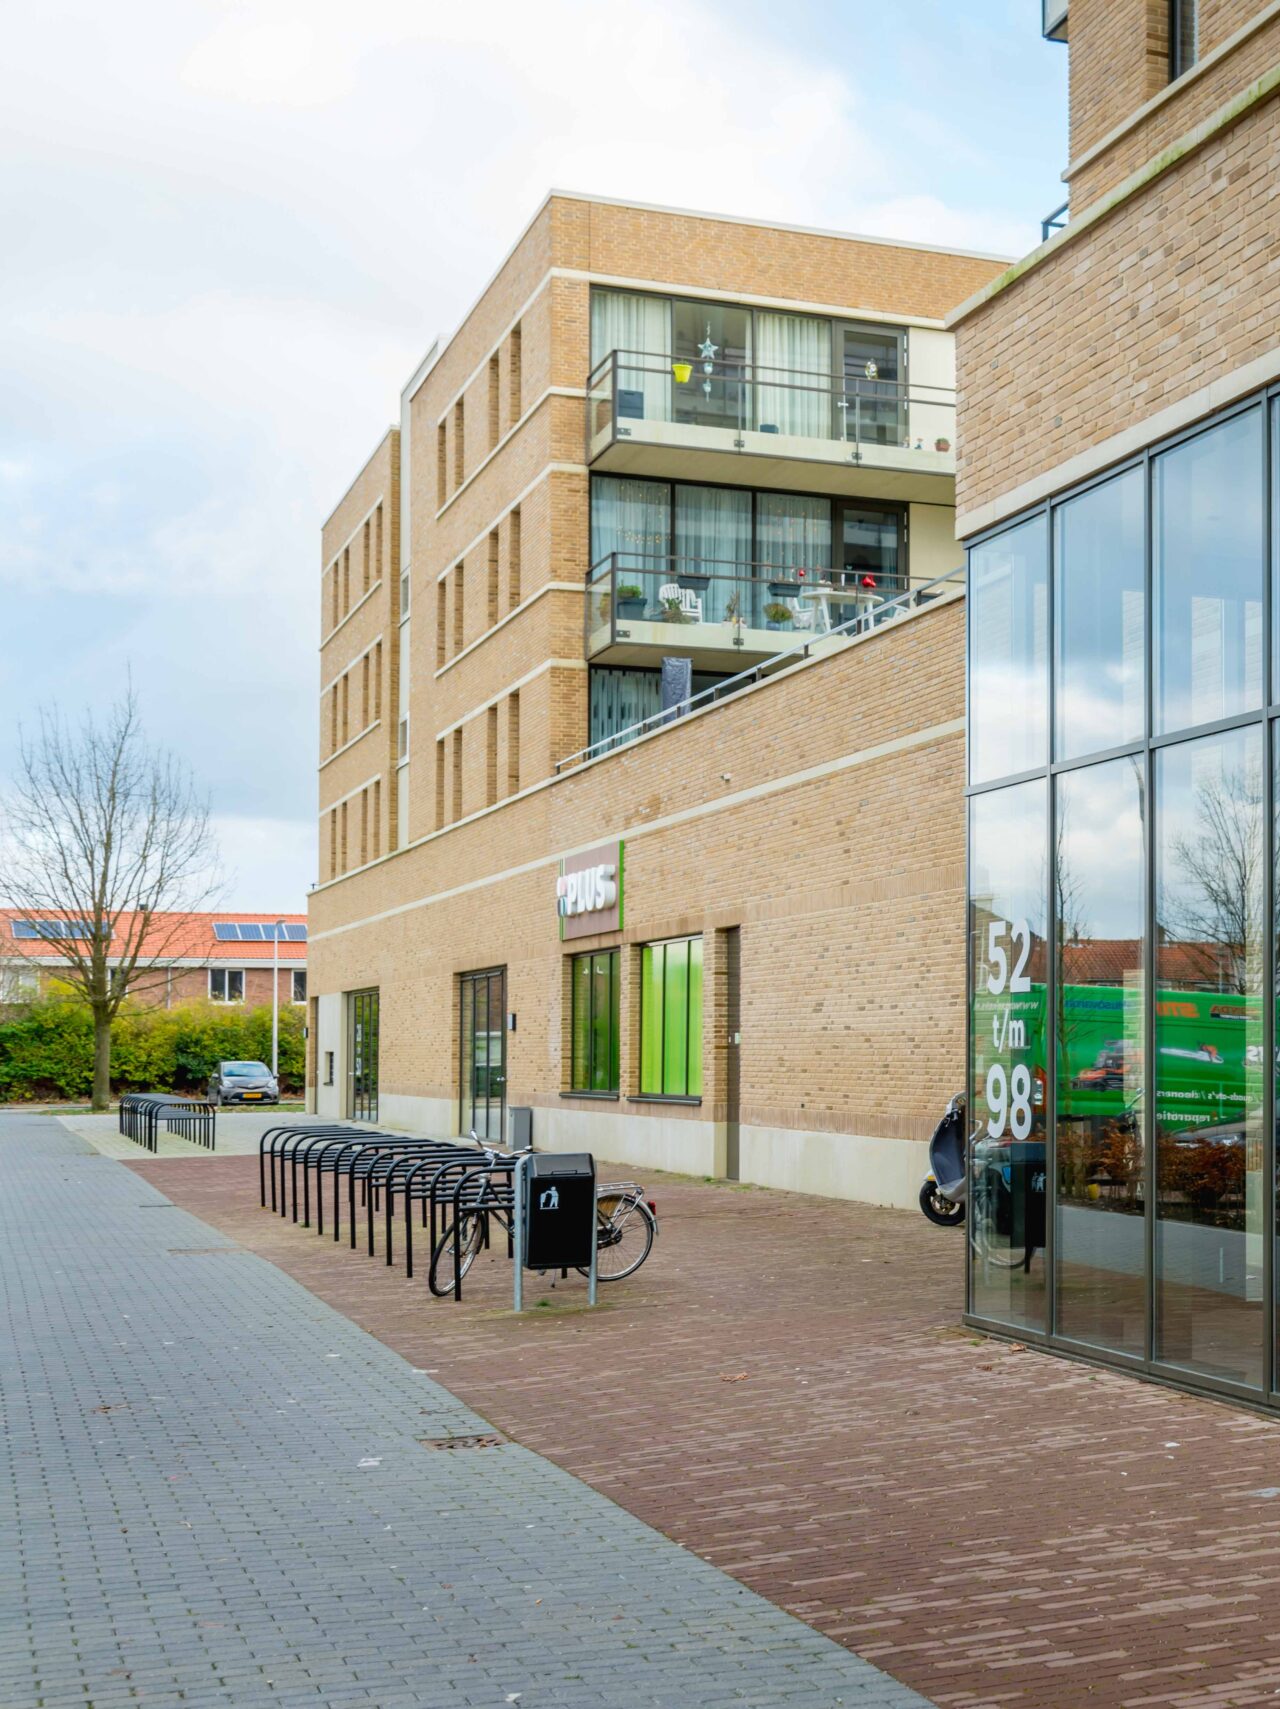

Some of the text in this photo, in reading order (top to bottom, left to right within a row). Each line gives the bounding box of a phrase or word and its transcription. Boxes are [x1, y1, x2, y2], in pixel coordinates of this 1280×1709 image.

[567, 863, 616, 916] PLUS
[986, 919, 1032, 995] 52
[992, 1008, 1025, 1053] t/m
[986, 1063, 1032, 1141] 98
